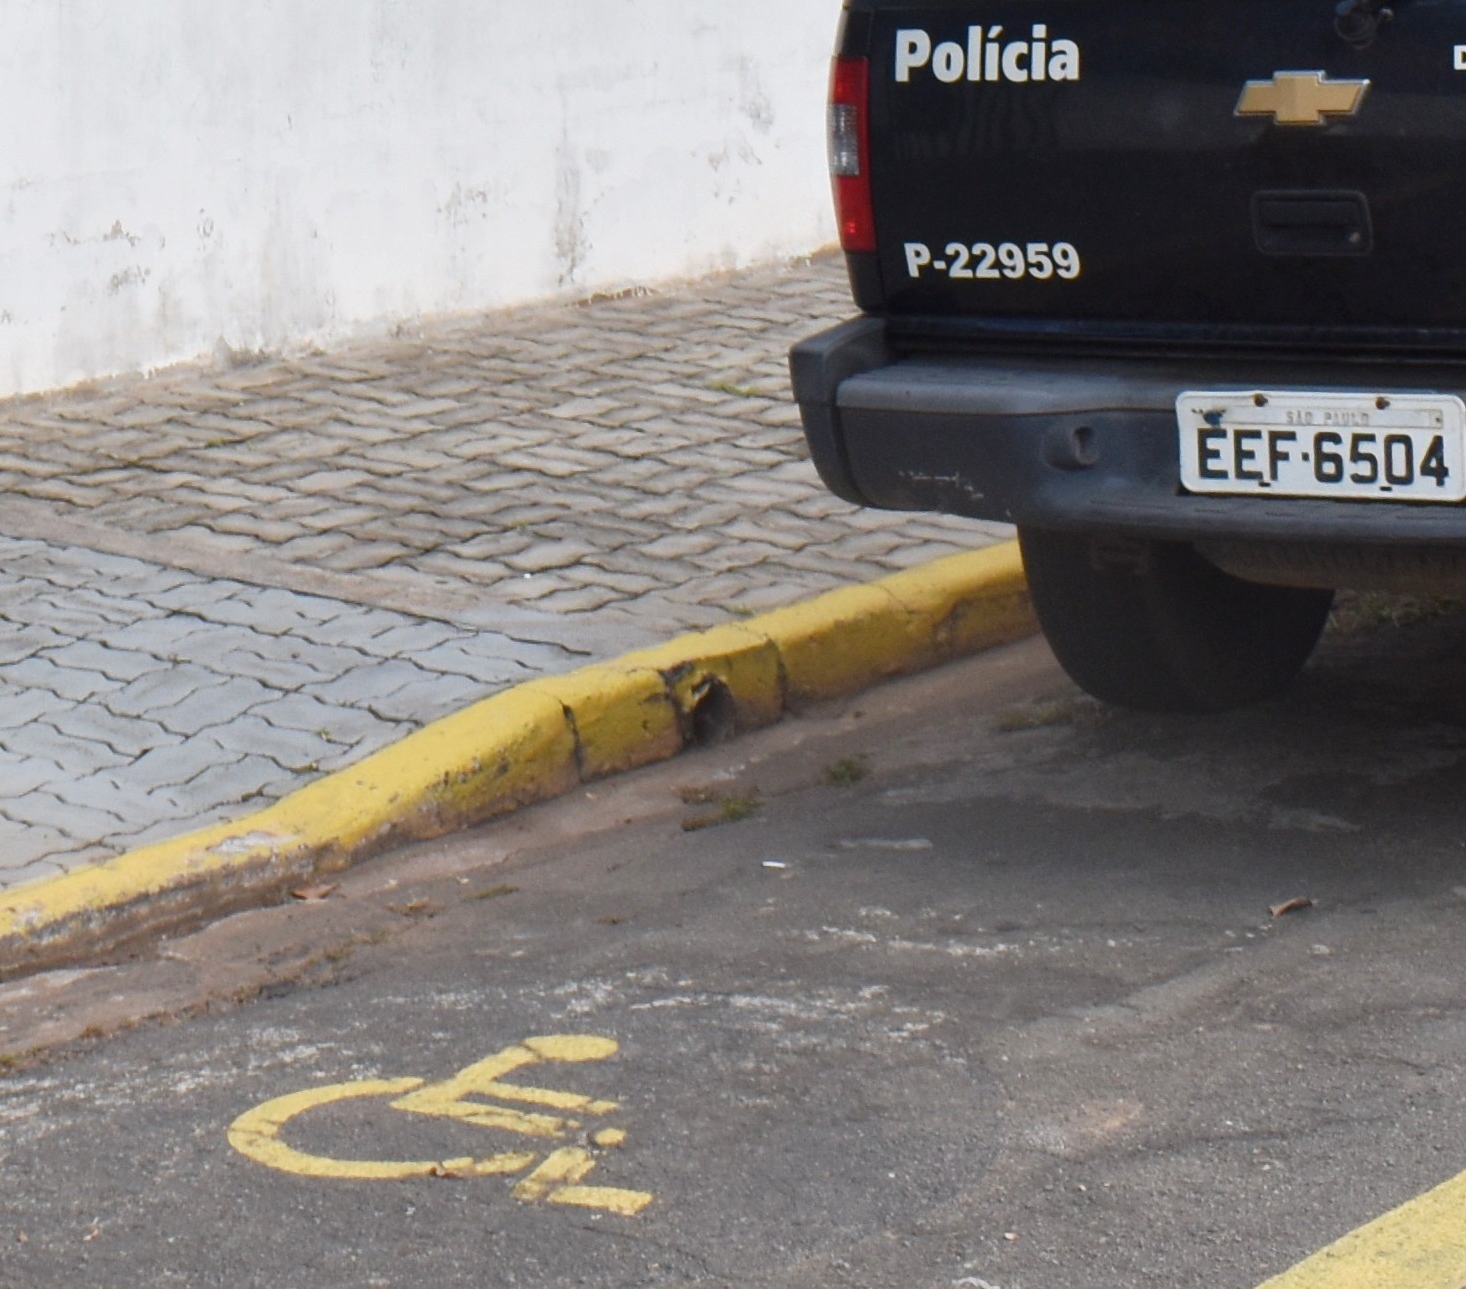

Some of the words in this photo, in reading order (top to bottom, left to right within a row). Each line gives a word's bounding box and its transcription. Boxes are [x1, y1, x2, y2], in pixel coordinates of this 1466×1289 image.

[894, 23, 1081, 83] Polícia
[903, 241, 1081, 279] P-22959
[1323, 411, 1371, 426] PAULO
